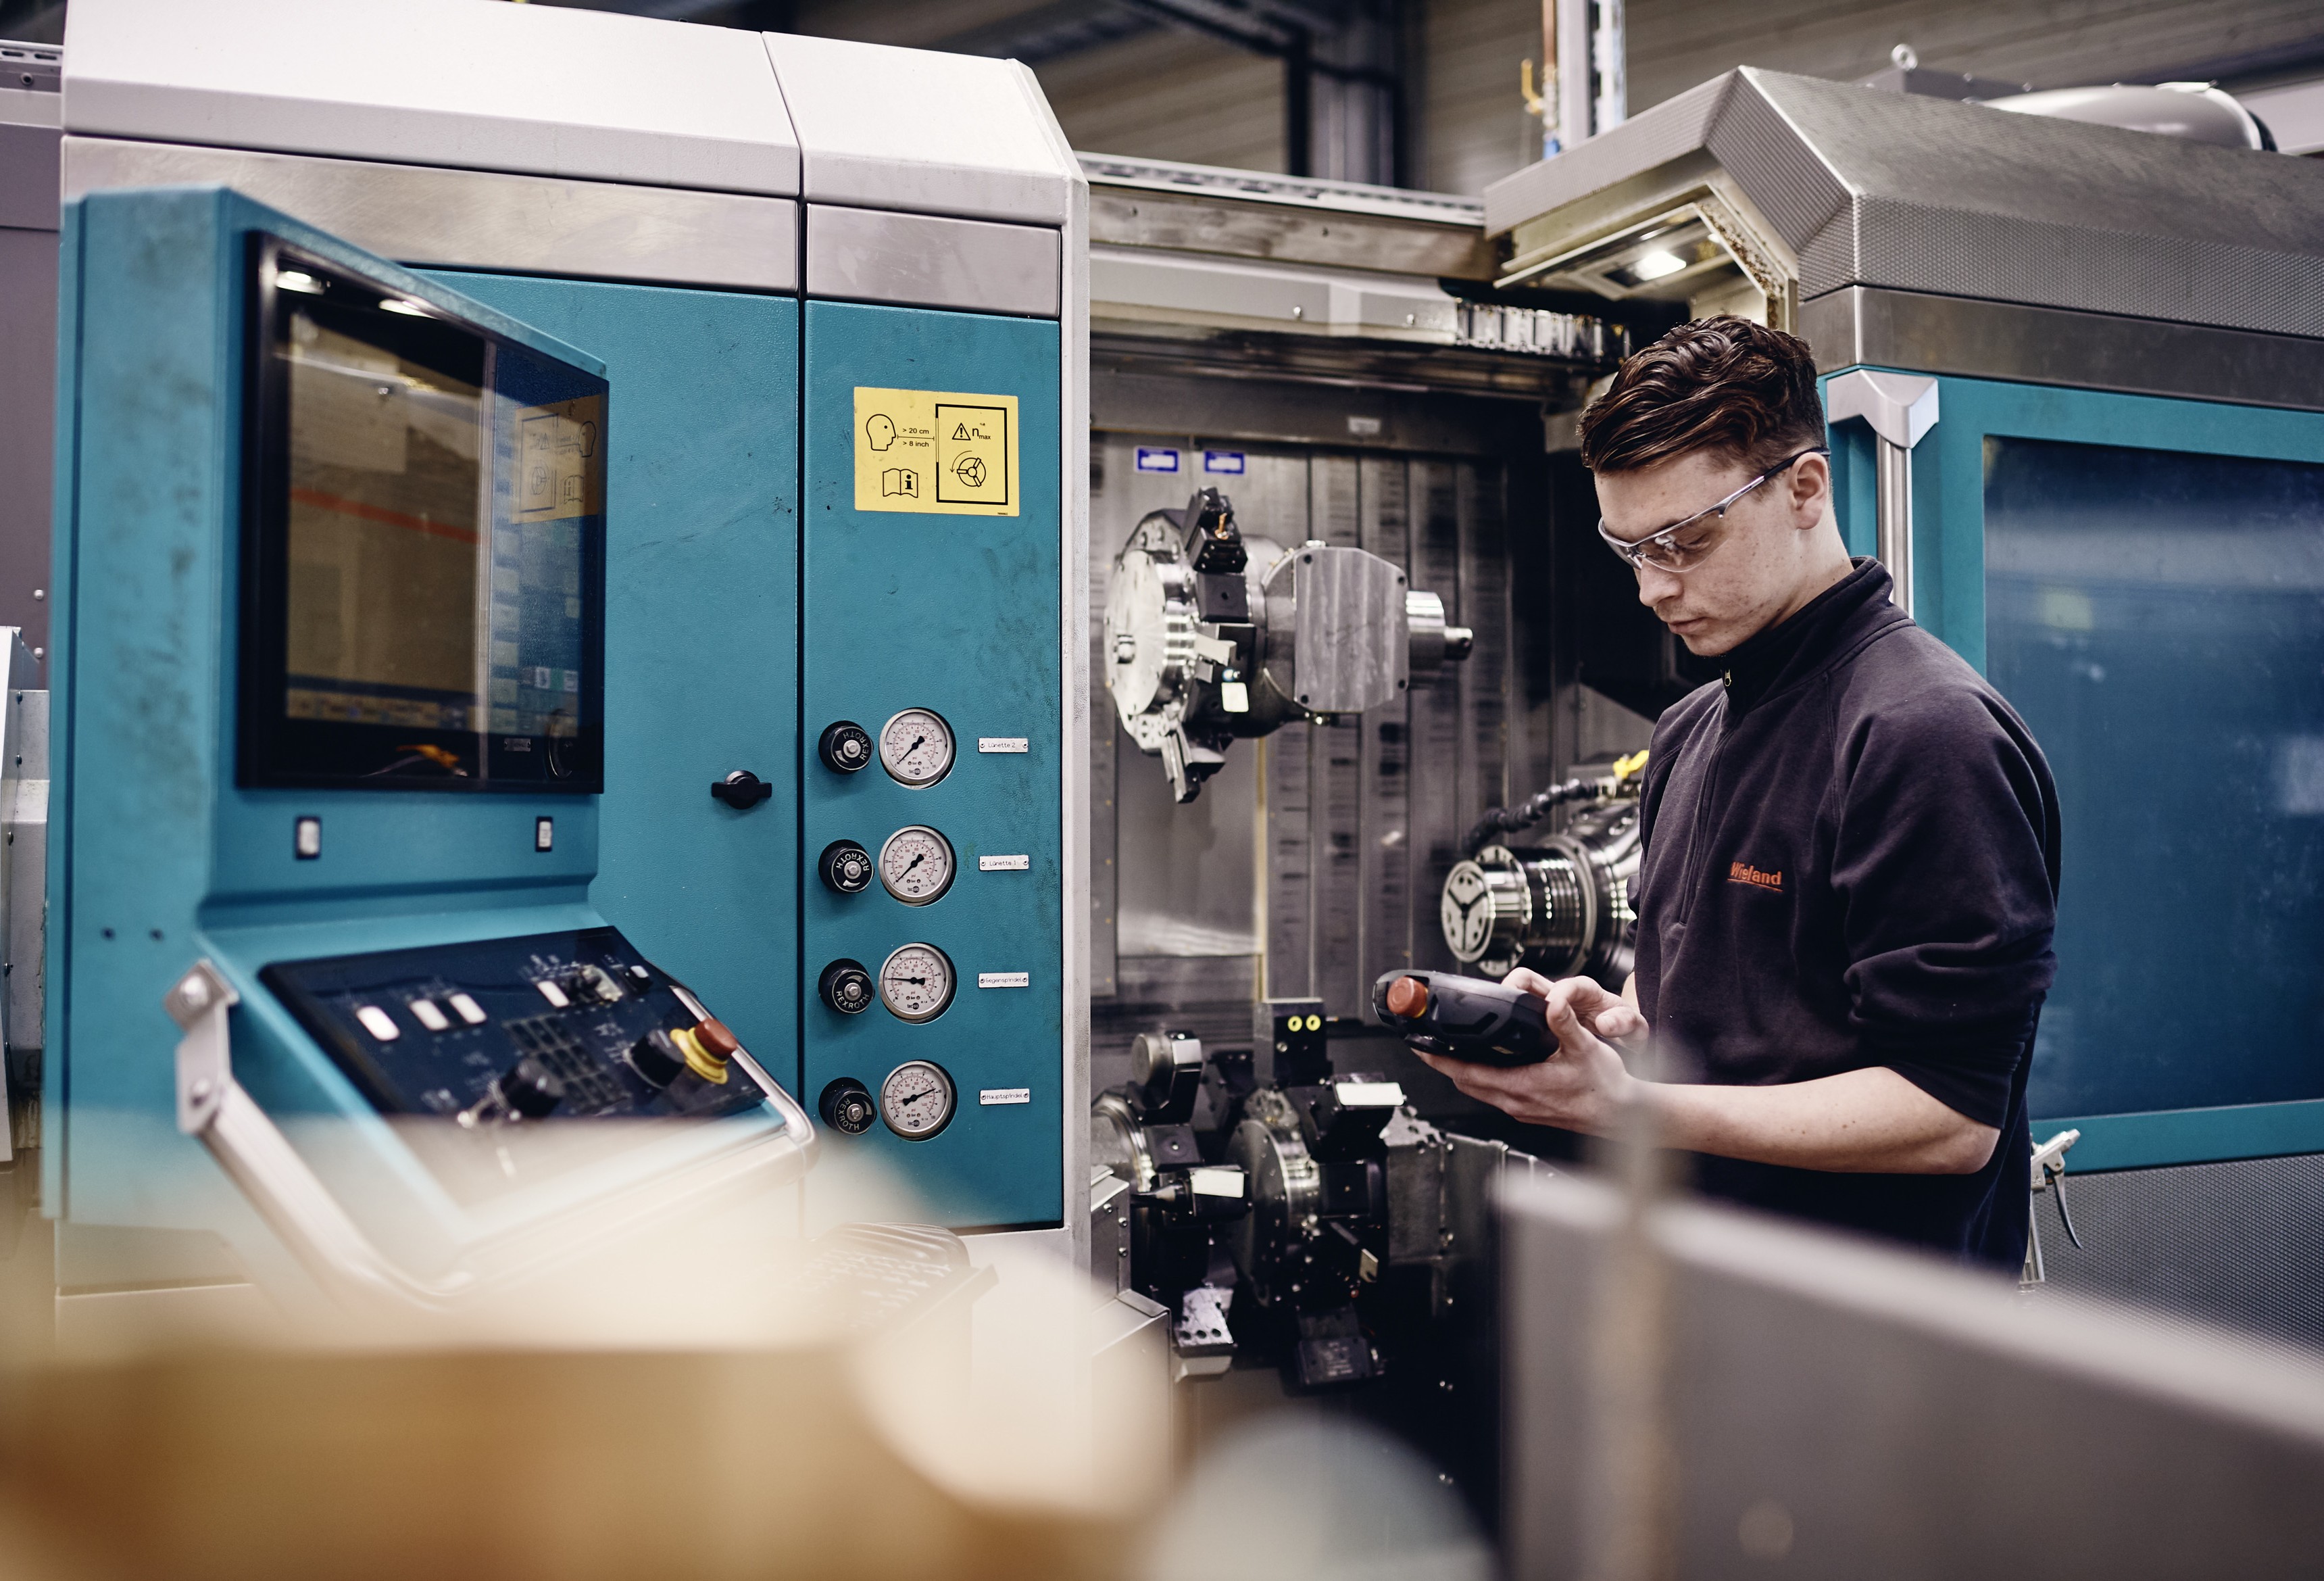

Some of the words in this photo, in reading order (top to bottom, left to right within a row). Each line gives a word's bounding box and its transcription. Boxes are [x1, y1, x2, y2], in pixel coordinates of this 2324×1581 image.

[843, 731, 869, 760] REXROTH
[836, 853, 870, 871] REXROTH
[1730, 862, 1782, 885] Wieland
[836, 991, 870, 1009] REXROTH
[839, 1098, 860, 1130] REXROTH
